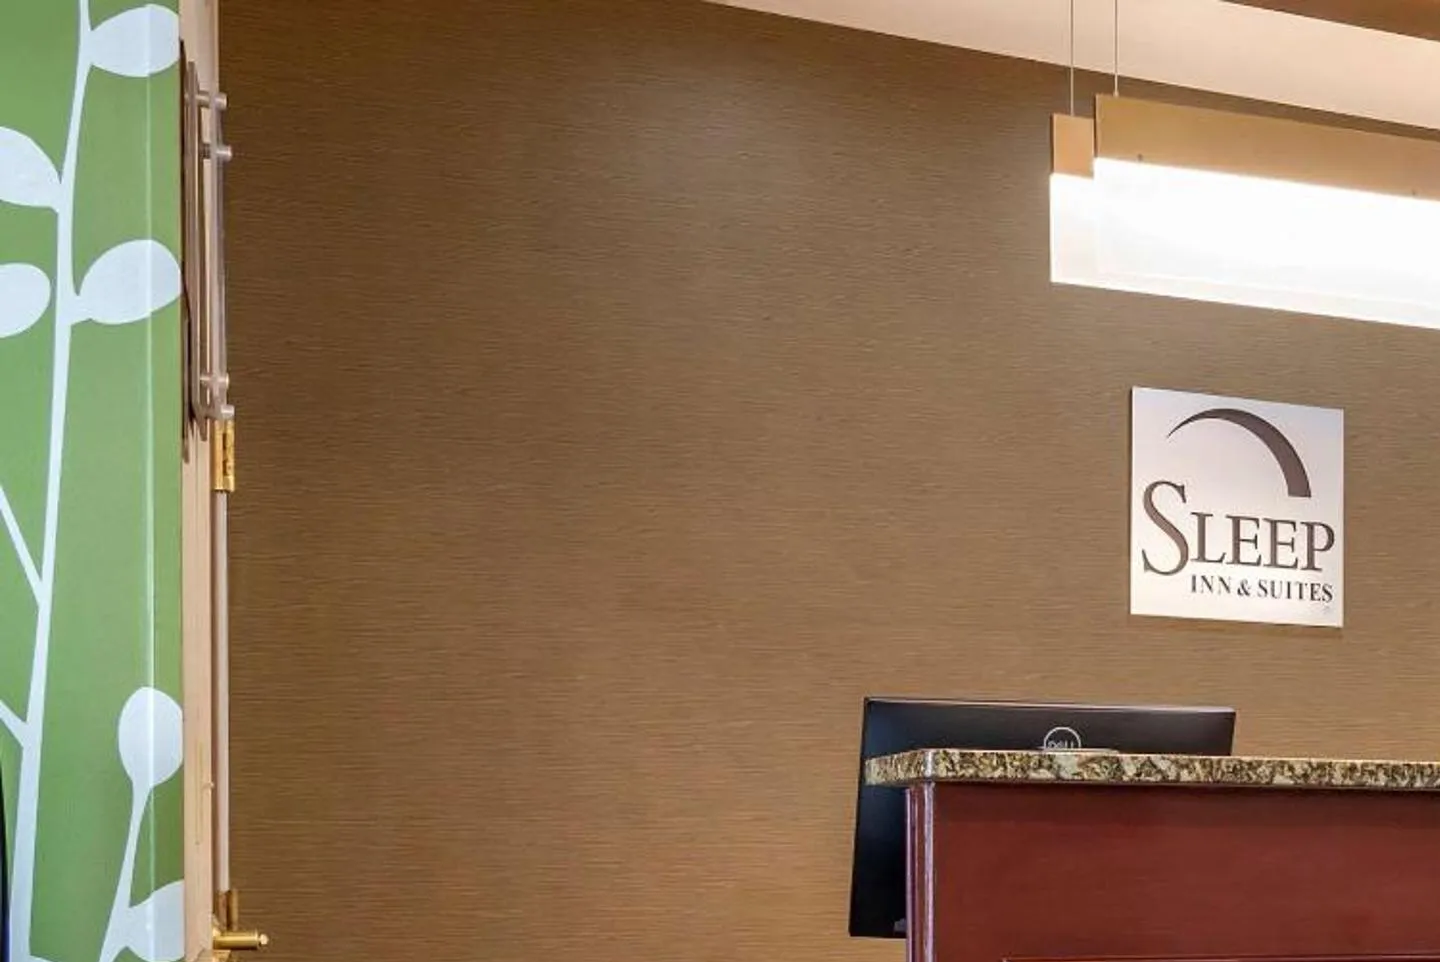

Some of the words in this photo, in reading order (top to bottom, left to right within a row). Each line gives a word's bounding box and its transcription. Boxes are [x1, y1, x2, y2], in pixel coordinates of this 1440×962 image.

[1142, 480, 1335, 576] SLEEP
[1191, 574, 1232, 595] INN
[1237, 579, 1251, 597] &
[1257, 578, 1333, 602] SUITES
